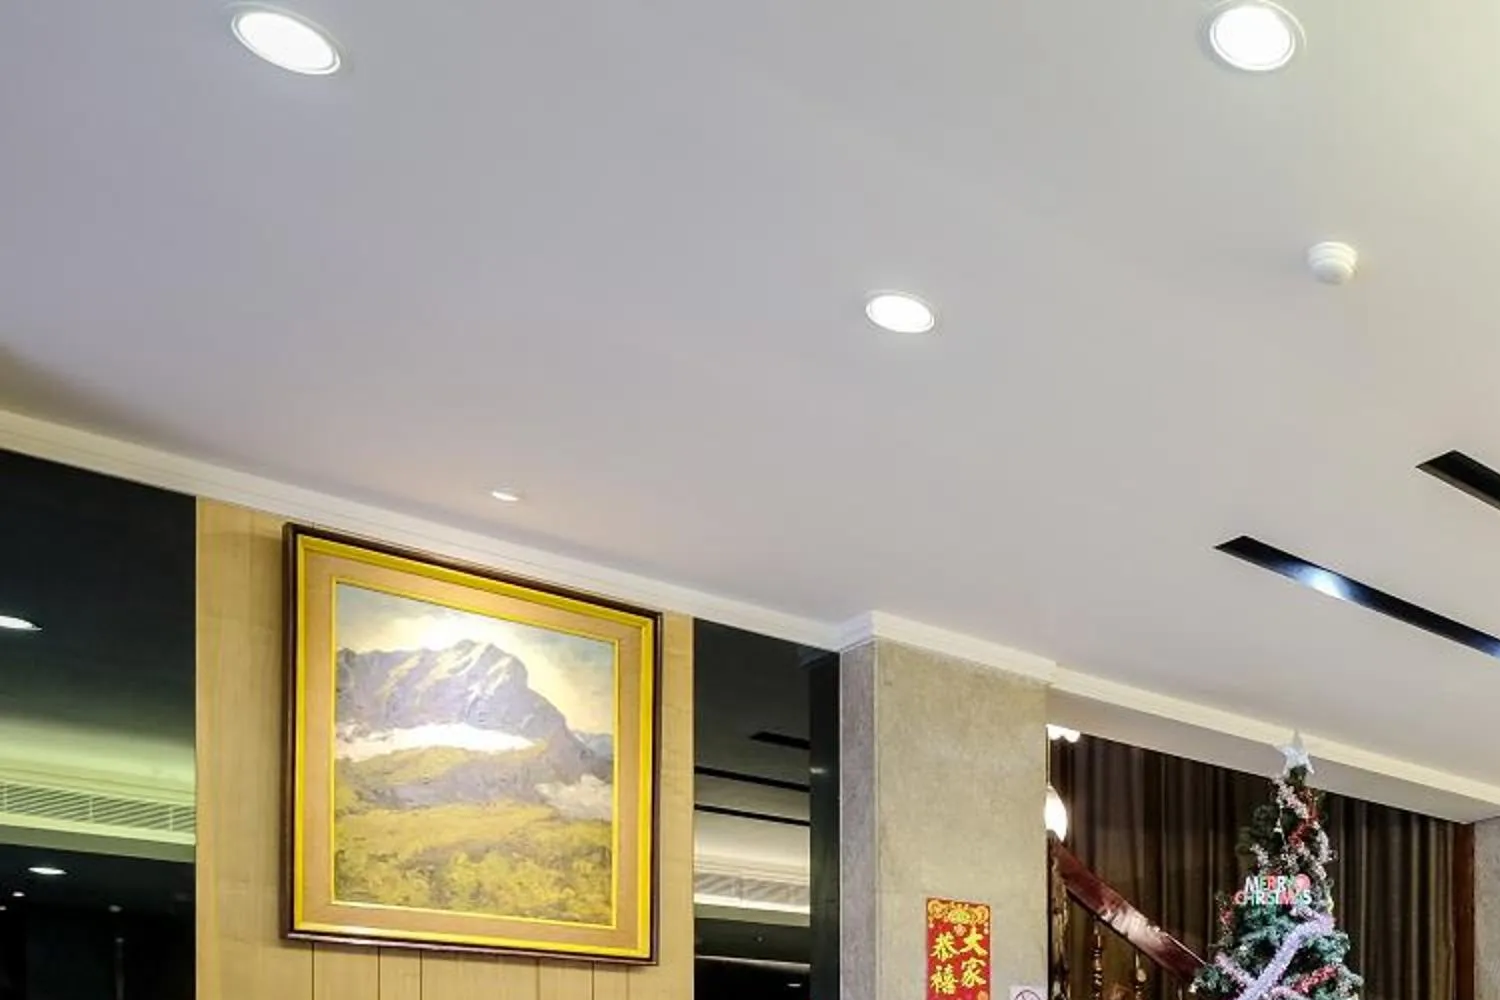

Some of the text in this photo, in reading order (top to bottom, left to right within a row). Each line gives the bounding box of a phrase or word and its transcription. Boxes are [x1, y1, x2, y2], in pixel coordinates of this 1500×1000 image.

[1244, 875, 1296, 891] MERRY
[1234, 889, 1312, 905] CHRISTMAS
[958, 926, 988, 989] 大家
